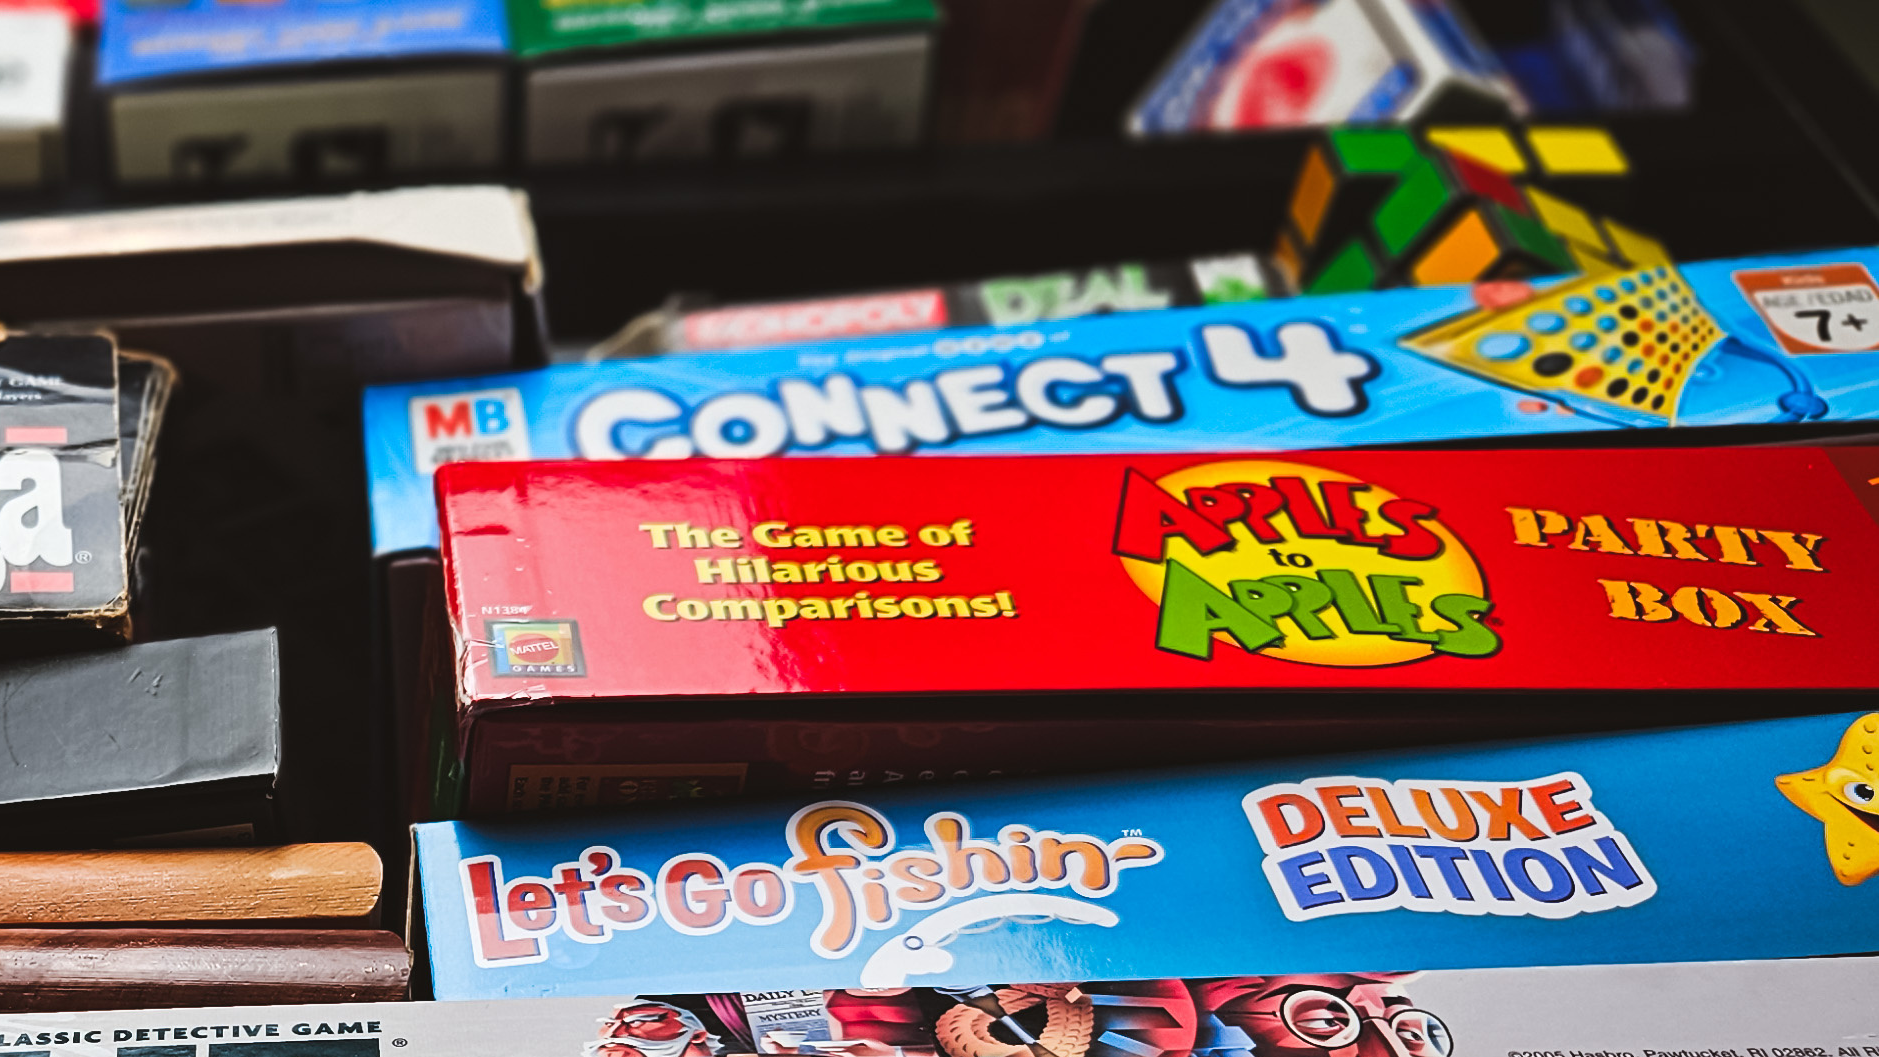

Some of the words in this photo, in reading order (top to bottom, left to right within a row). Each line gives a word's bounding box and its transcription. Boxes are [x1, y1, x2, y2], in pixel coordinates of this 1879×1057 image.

[984, 265, 1170, 326] DEAL
[1794, 309, 1868, 342] 7+
[9, 375, 62, 387] GAME
[575, 352, 1182, 459] CONNECT
[1198, 322, 1378, 413] 4
[424, 398, 510, 438] MB
[1111, 466, 1445, 564] APPLES
[639, 521, 742, 549] The
[753, 520, 909, 549] Game
[919, 518, 975, 548] of
[1505, 506, 1827, 572] PARTY
[694, 556, 945, 584] Hilarious
[1268, 548, 1313, 569] to
[642, 591, 1020, 629] Comparisons!
[1155, 558, 1504, 661] APPLES
[1597, 578, 1820, 637] BOX
[510, 640, 559, 655] MATTEL
[512, 664, 576, 673] GAMES
[1257, 779, 1597, 849] DELUXE
[1278, 836, 1645, 910] EDITION
[463, 850, 651, 962] Let's
[663, 856, 787, 929] Go
[742, 990, 794, 1002] DAILY
[112, 1023, 280, 1042] DETECTIVE
[291, 1020, 383, 1036] GAME
[759, 1009, 821, 1022] MYSTERY
[1747, 1048, 1770, 1057] RI
[1838, 1046, 1861, 1057] All
